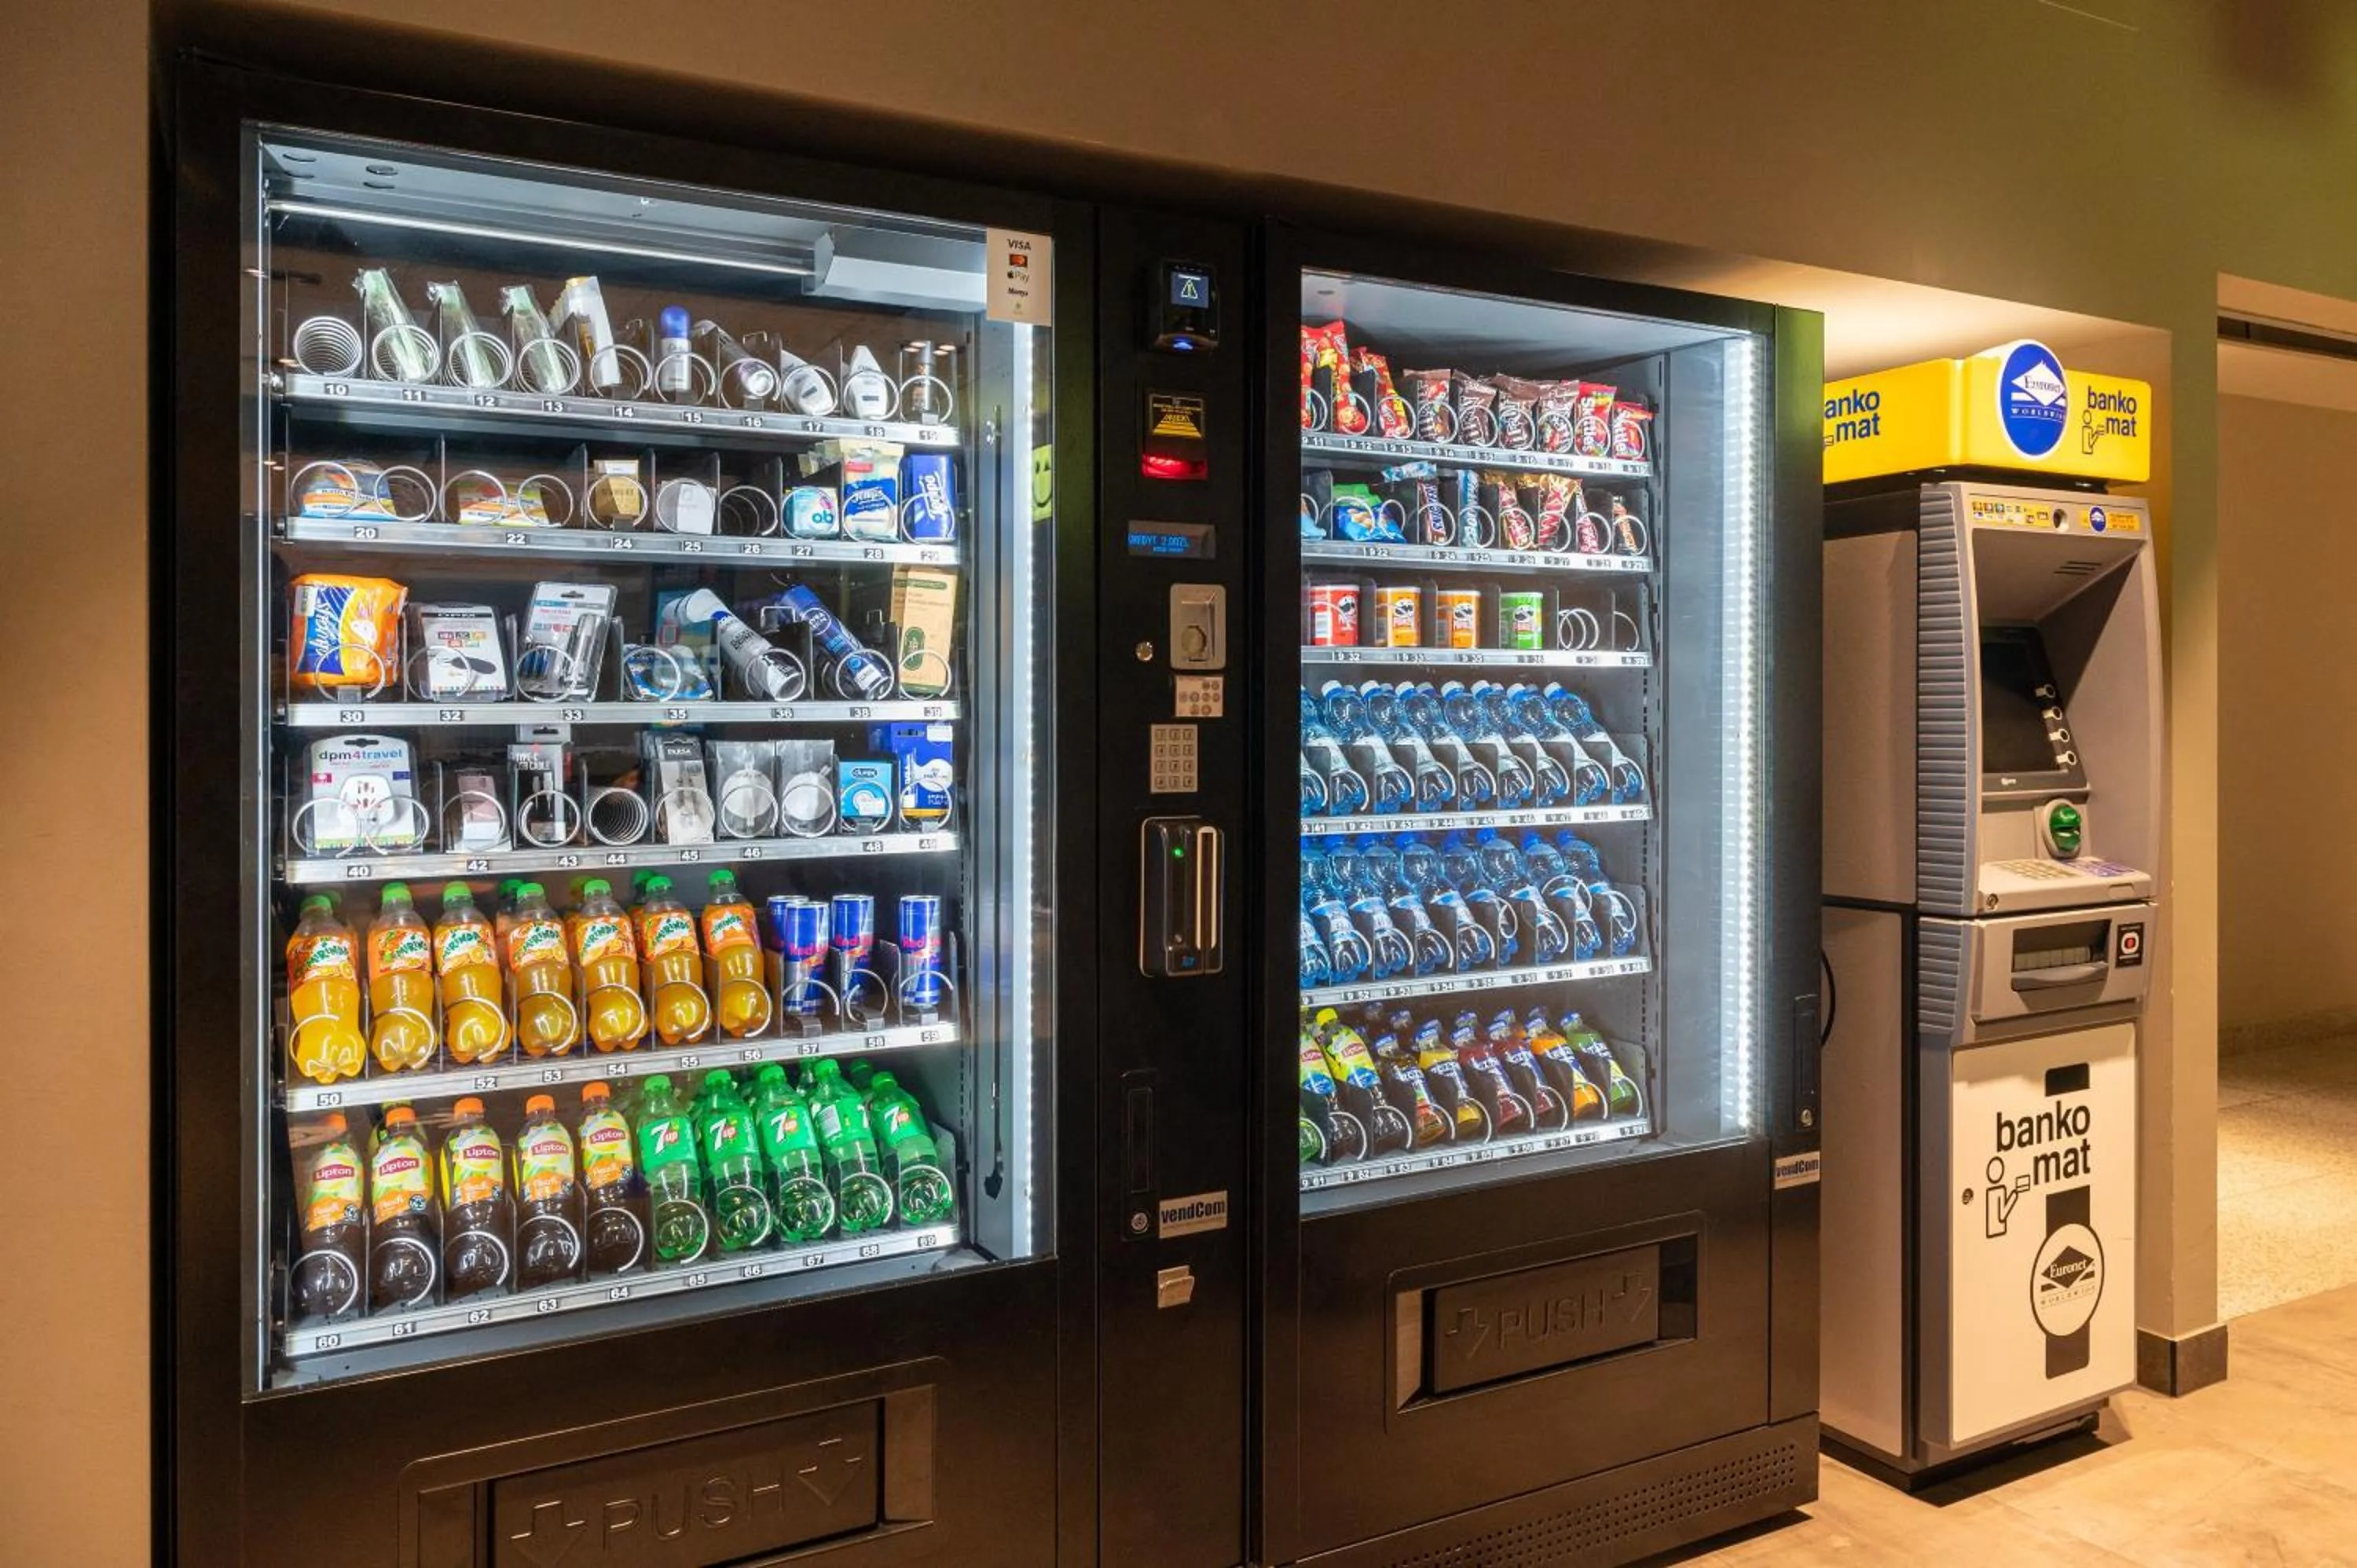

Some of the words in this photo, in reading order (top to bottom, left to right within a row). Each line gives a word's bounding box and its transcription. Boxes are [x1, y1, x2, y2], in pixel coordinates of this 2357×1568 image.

[1007, 239, 1031, 251] VISA
[327, 384, 347, 394] 10
[406, 390, 423, 401] 11
[476, 395, 496, 406] 12
[1824, 388, 1880, 418] anko
[2087, 386, 2137, 416] banko
[545, 401, 563, 412] 13
[615, 407, 633, 417] 14
[685, 412, 702, 423] 15
[807, 422, 823, 432] 17
[1836, 416, 1880, 442] mat
[2106, 416, 2137, 438] mat
[918, 471, 948, 521] Tempo
[356, 528, 375, 538] 20
[507, 533, 526, 544] 22
[614, 539, 632, 549] 24
[684, 540, 702, 551] 25
[797, 545, 812, 555] 27
[343, 711, 362, 721] 30
[442, 710, 460, 720] 32
[564, 710, 581, 720] 33
[670, 709, 687, 719] 35
[318, 749, 403, 762] dpm4travel
[744, 848, 761, 857] 46
[866, 843, 881, 852] 48
[559, 856, 577, 866] 43
[607, 855, 625, 864] 44
[682, 852, 698, 861] 45
[468, 860, 487, 870] 42
[349, 866, 368, 877] 40
[802, 1044, 818, 1053] 57
[745, 1050, 761, 1060] 56
[682, 1057, 698, 1067] 55
[609, 1064, 625, 1074] 54
[544, 1071, 562, 1081] 53
[476, 1078, 496, 1088] 52
[319, 1094, 339, 1105] 50
[1996, 1101, 2091, 1152] banko
[592, 1130, 625, 1142] Lipton
[534, 1142, 566, 1152] Lipton
[467, 1149, 498, 1158] Lipton
[2033, 1138, 2091, 1185] mat
[381, 1160, 416, 1174] Lipton
[316, 1167, 352, 1179] Lipton
[1160, 1199, 1226, 1223] vendCom
[808, 1255, 823, 1265] 67
[745, 1266, 761, 1276] 66
[2049, 1259, 2088, 1278] Euronet
[690, 1275, 706, 1285] 65
[611, 1288, 628, 1299] 64
[539, 1300, 557, 1310] 63
[470, 1311, 489, 1322] 62
[1497, 1288, 1606, 1350] PUSH
[394, 1324, 412, 1334] 61
[318, 1336, 339, 1346] 60
[602, 1466, 783, 1551] PUSH
